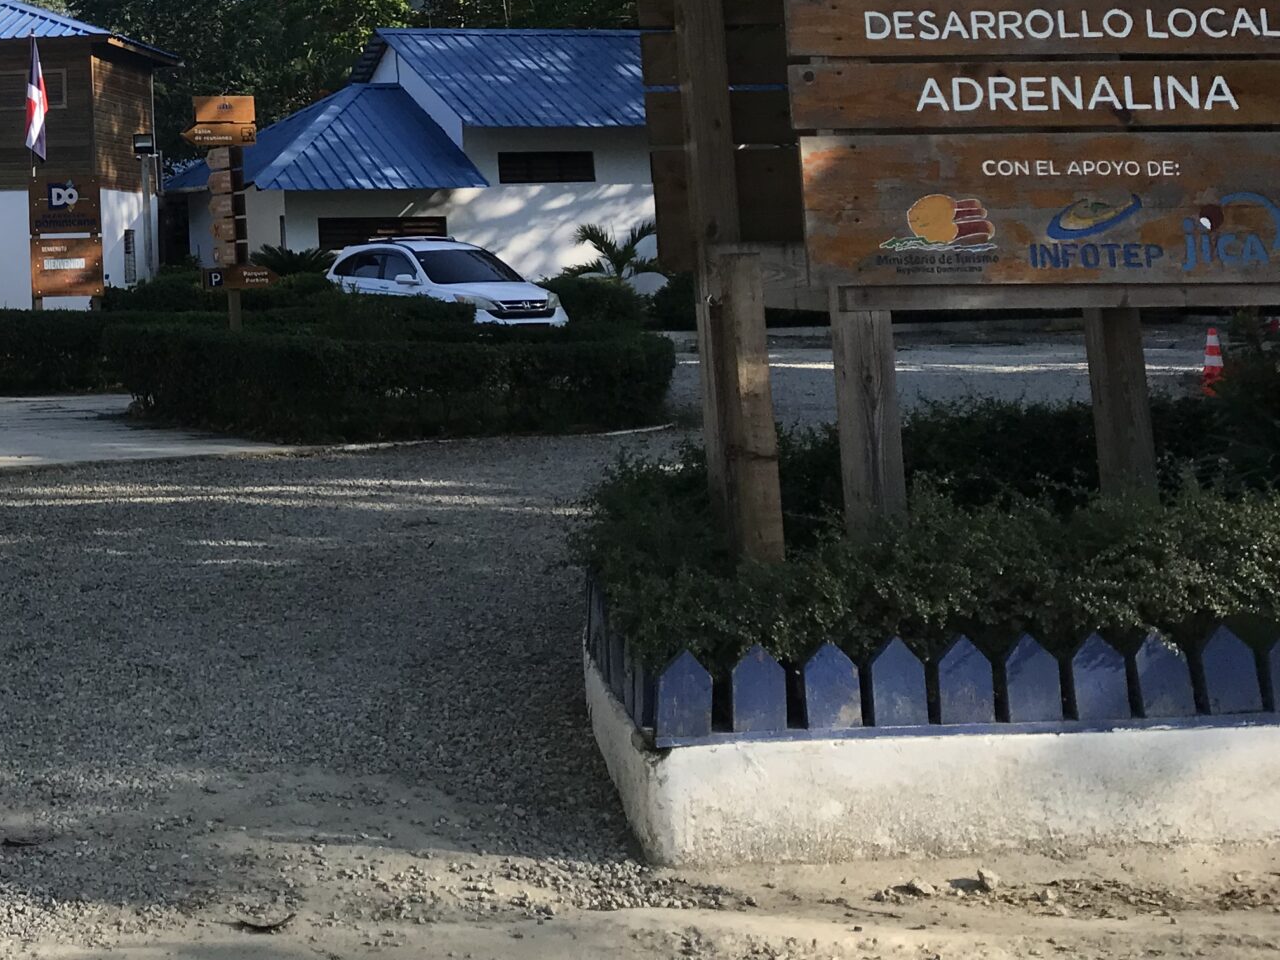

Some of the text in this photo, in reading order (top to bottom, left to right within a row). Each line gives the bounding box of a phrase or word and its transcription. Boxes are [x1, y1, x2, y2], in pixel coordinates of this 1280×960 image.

[864, 6, 1280, 41] DESARROLLO LOCAL
[916, 75, 1239, 112] ADRENALINA
[981, 159, 1181, 177] CON EL APOYO DE:
[1029, 243, 1164, 270] INFOTEP
[210, 273, 221, 286] P
